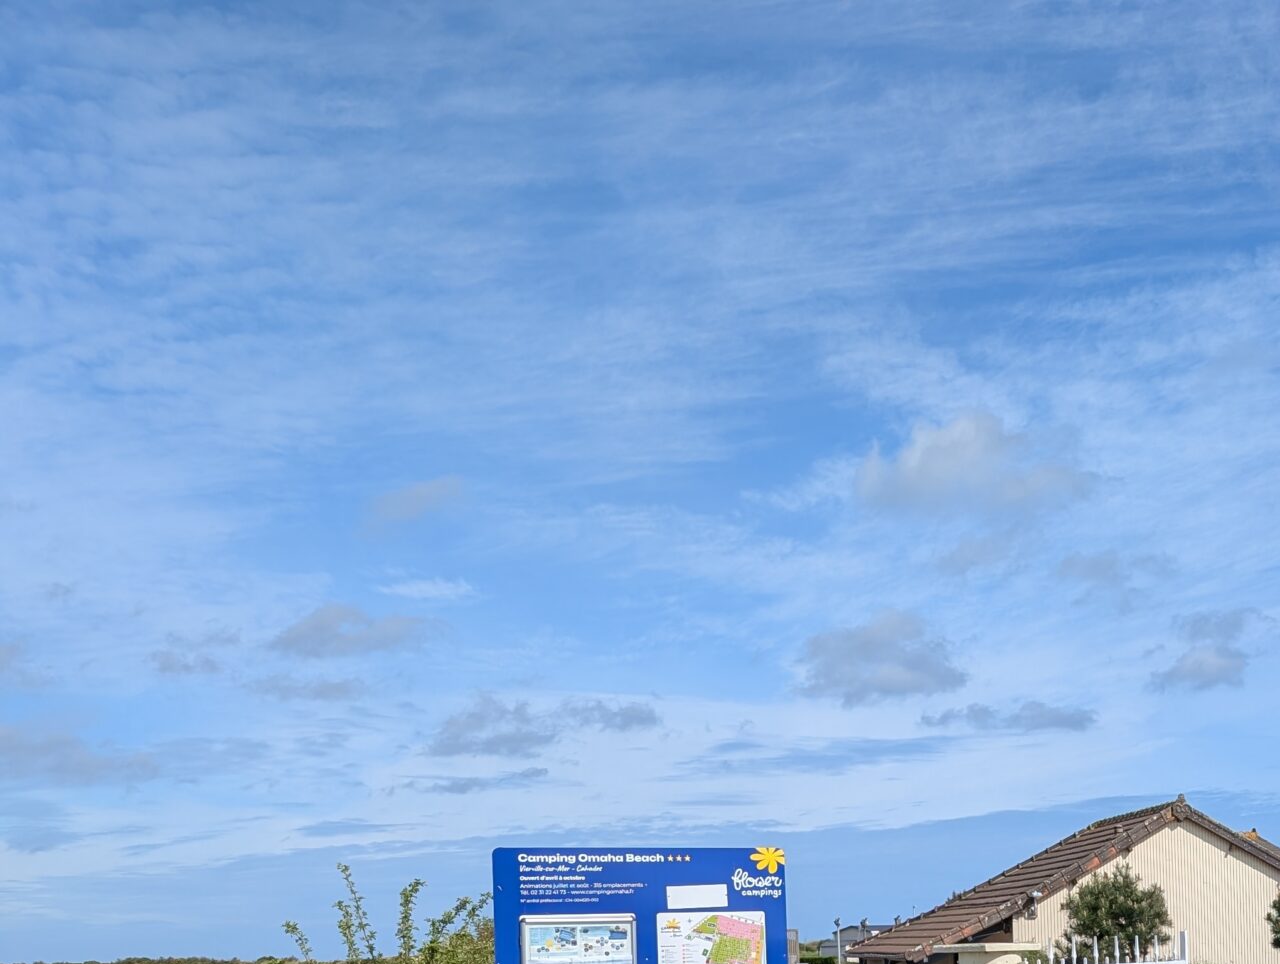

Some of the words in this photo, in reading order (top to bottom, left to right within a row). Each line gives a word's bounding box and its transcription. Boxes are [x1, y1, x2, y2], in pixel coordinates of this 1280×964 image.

[518, 853, 576, 864] Camping
[578, 853, 624, 862] Omaha
[625, 853, 665, 863] Beach
[731, 868, 783, 891] flower
[741, 887, 782, 898] campings
